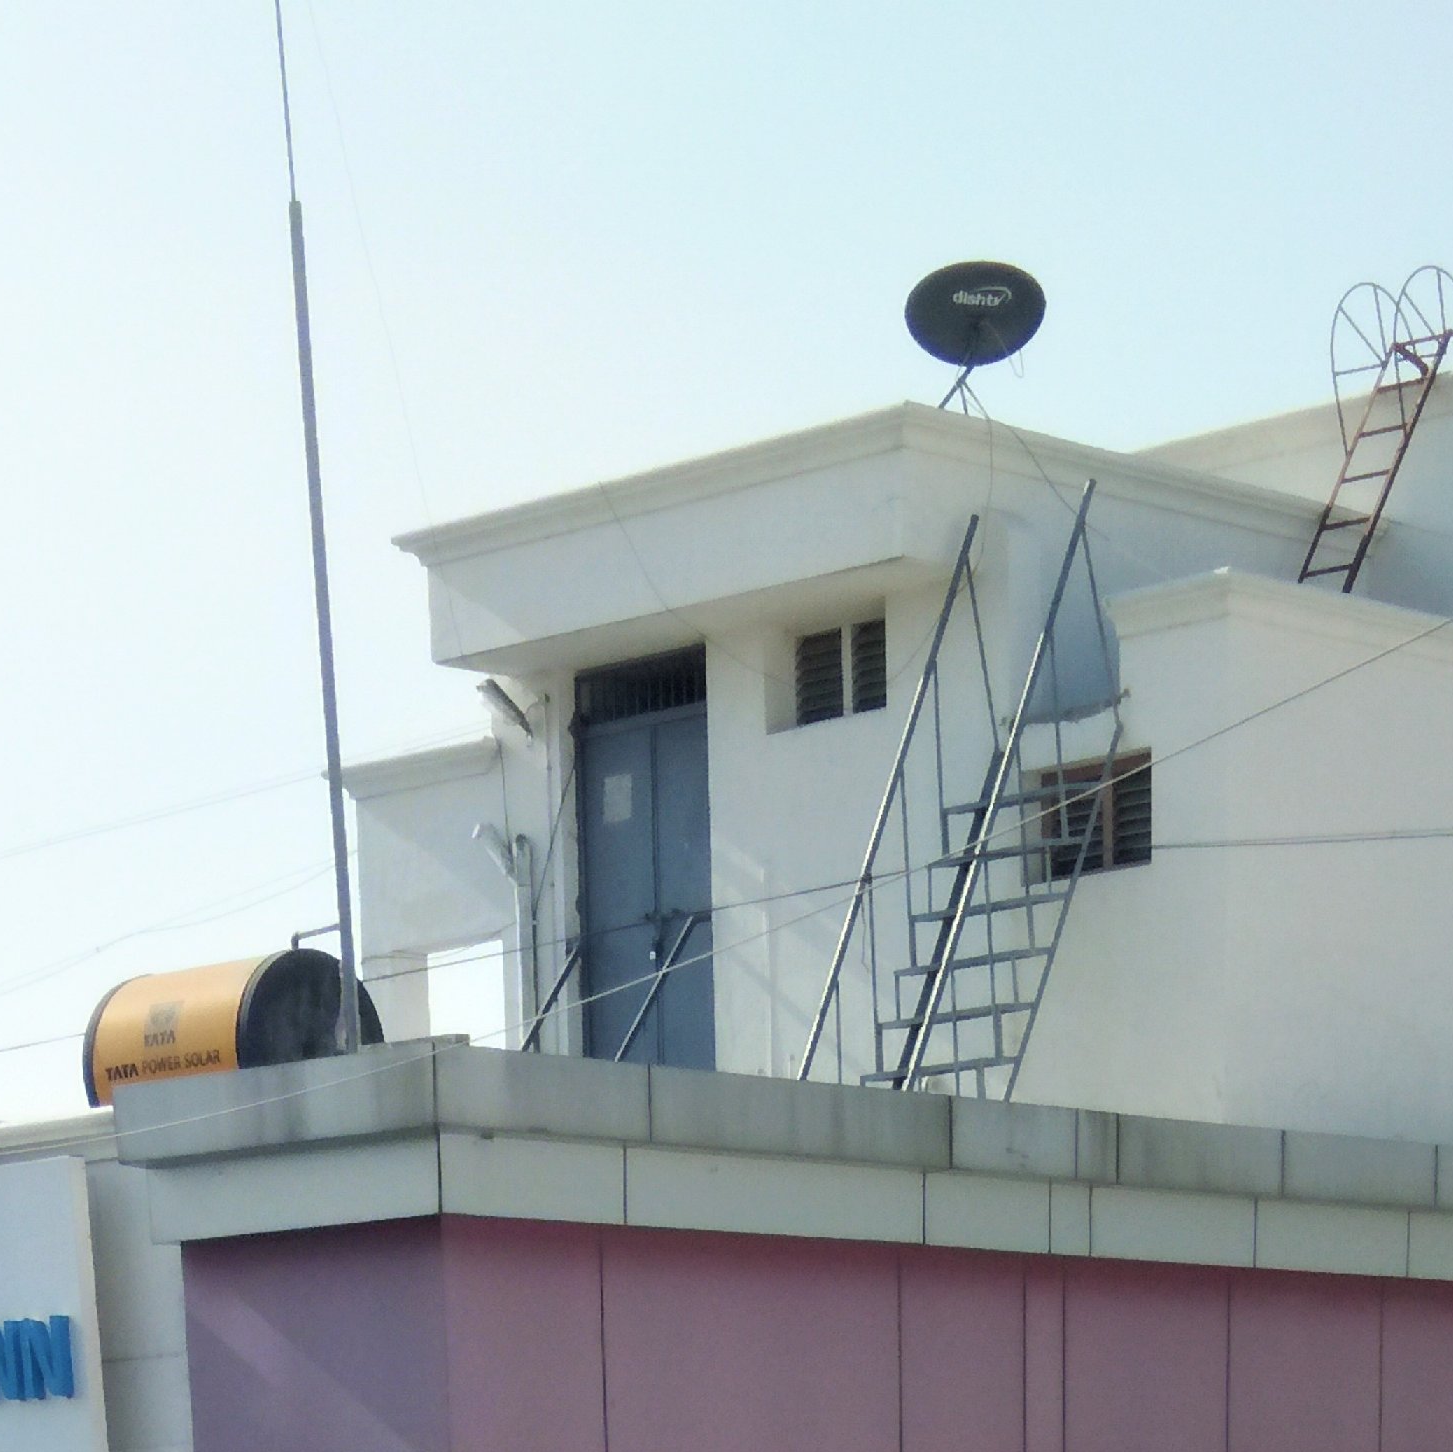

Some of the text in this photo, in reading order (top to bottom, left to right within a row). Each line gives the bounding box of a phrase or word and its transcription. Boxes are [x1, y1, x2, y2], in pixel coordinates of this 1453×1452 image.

[105, 1049, 220, 1081] TATA POWER SOLAR
